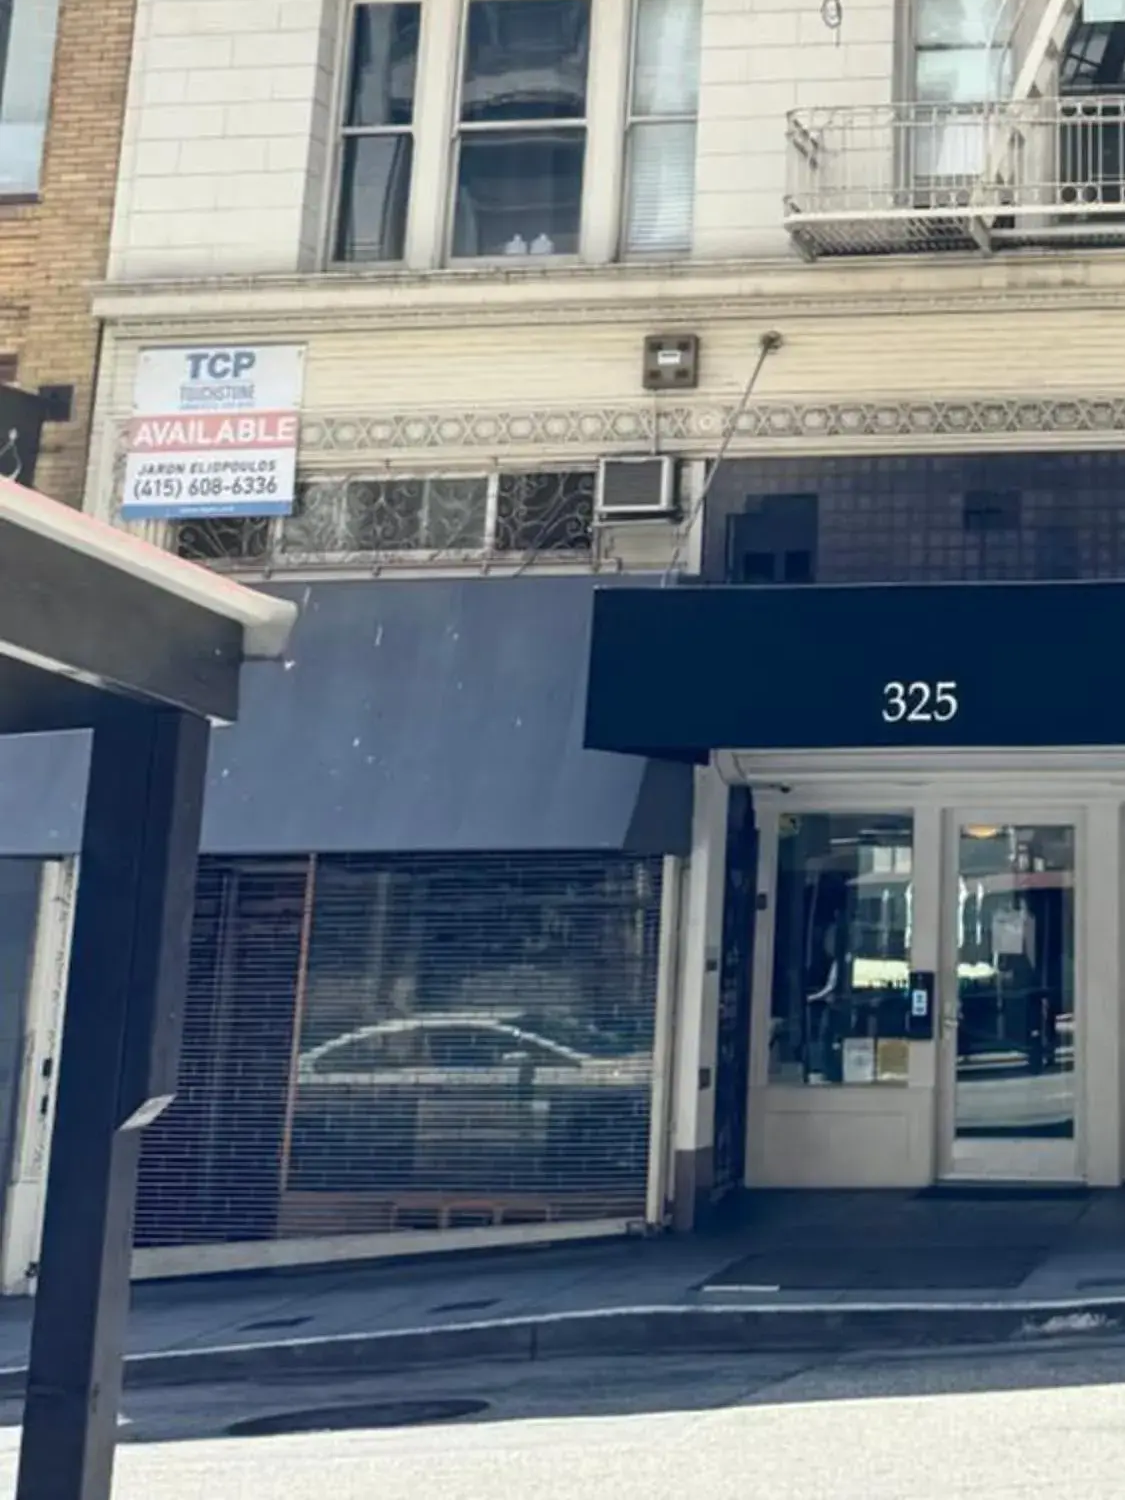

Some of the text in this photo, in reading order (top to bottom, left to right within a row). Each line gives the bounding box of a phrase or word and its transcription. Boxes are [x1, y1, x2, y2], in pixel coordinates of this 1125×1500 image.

[186, 351, 256, 380] TCP
[133, 416, 298, 447] AVAILABLE
[133, 475, 278, 499] (415) 608-6336
[881, 680, 958, 722] 325
